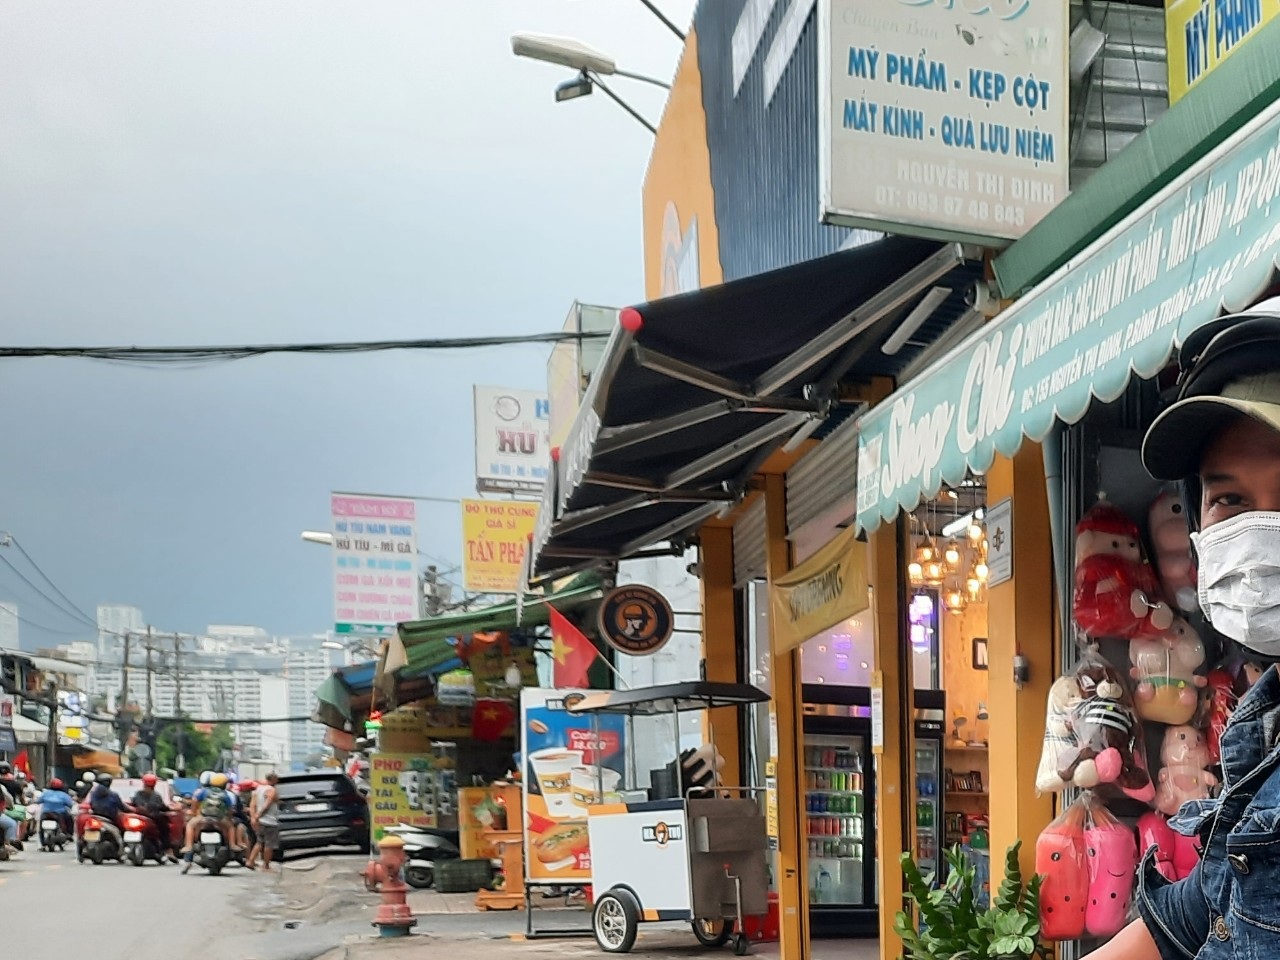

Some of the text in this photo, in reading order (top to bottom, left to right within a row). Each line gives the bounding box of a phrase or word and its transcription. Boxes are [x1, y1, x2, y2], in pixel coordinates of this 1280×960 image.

[848, 44, 879, 81] MỸ
[886, 48, 948, 93] PHẨM
[969, 68, 1007, 108] KẸP
[1013, 73, 1051, 116] CỘT
[843, 90, 878, 133] MẮT
[883, 99, 924, 141] KÍNH
[941, 113, 975, 150] QUÀ
[980, 121, 1010, 155] LƯU
[1015, 125, 1055, 167] NIỆM
[897, 157, 970, 191] NGUYỄN
[975, 171, 1004, 201] THỊ
[1072, 272, 1093, 335] CÁC
[1090, 262, 1116, 327] LOẠI
[1128, 209, 1164, 297] PHẨM
[1166, 186, 1197, 272] MẮT
[1192, 178, 1227, 255] KÍNH
[1229, 158, 1263, 236] KẸP
[1049, 348, 1084, 396] NGUYỄN
[1083, 343, 1099, 376] THỊ
[881, 393, 956, 499] Shop
